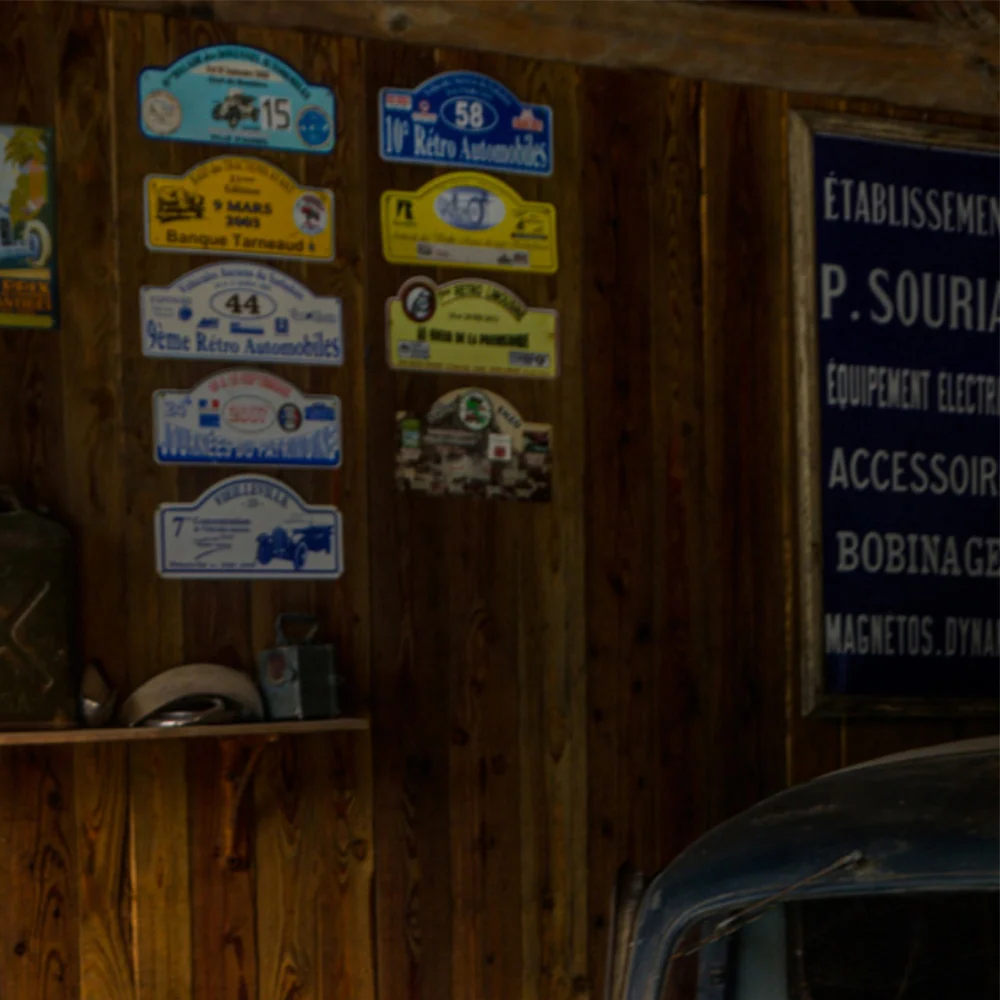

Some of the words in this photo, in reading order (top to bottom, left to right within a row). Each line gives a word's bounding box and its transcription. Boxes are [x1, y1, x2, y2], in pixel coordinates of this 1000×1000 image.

[262, 98, 291, 130] 15
[454, 100, 485, 129] 58
[226, 200, 272, 215] MARS
[166, 229, 228, 249] Banque
[224, 293, 261, 315] 44
[828, 446, 1000, 498] ACCESSOIR
[835, 529, 1000, 578] BOBINAGE
